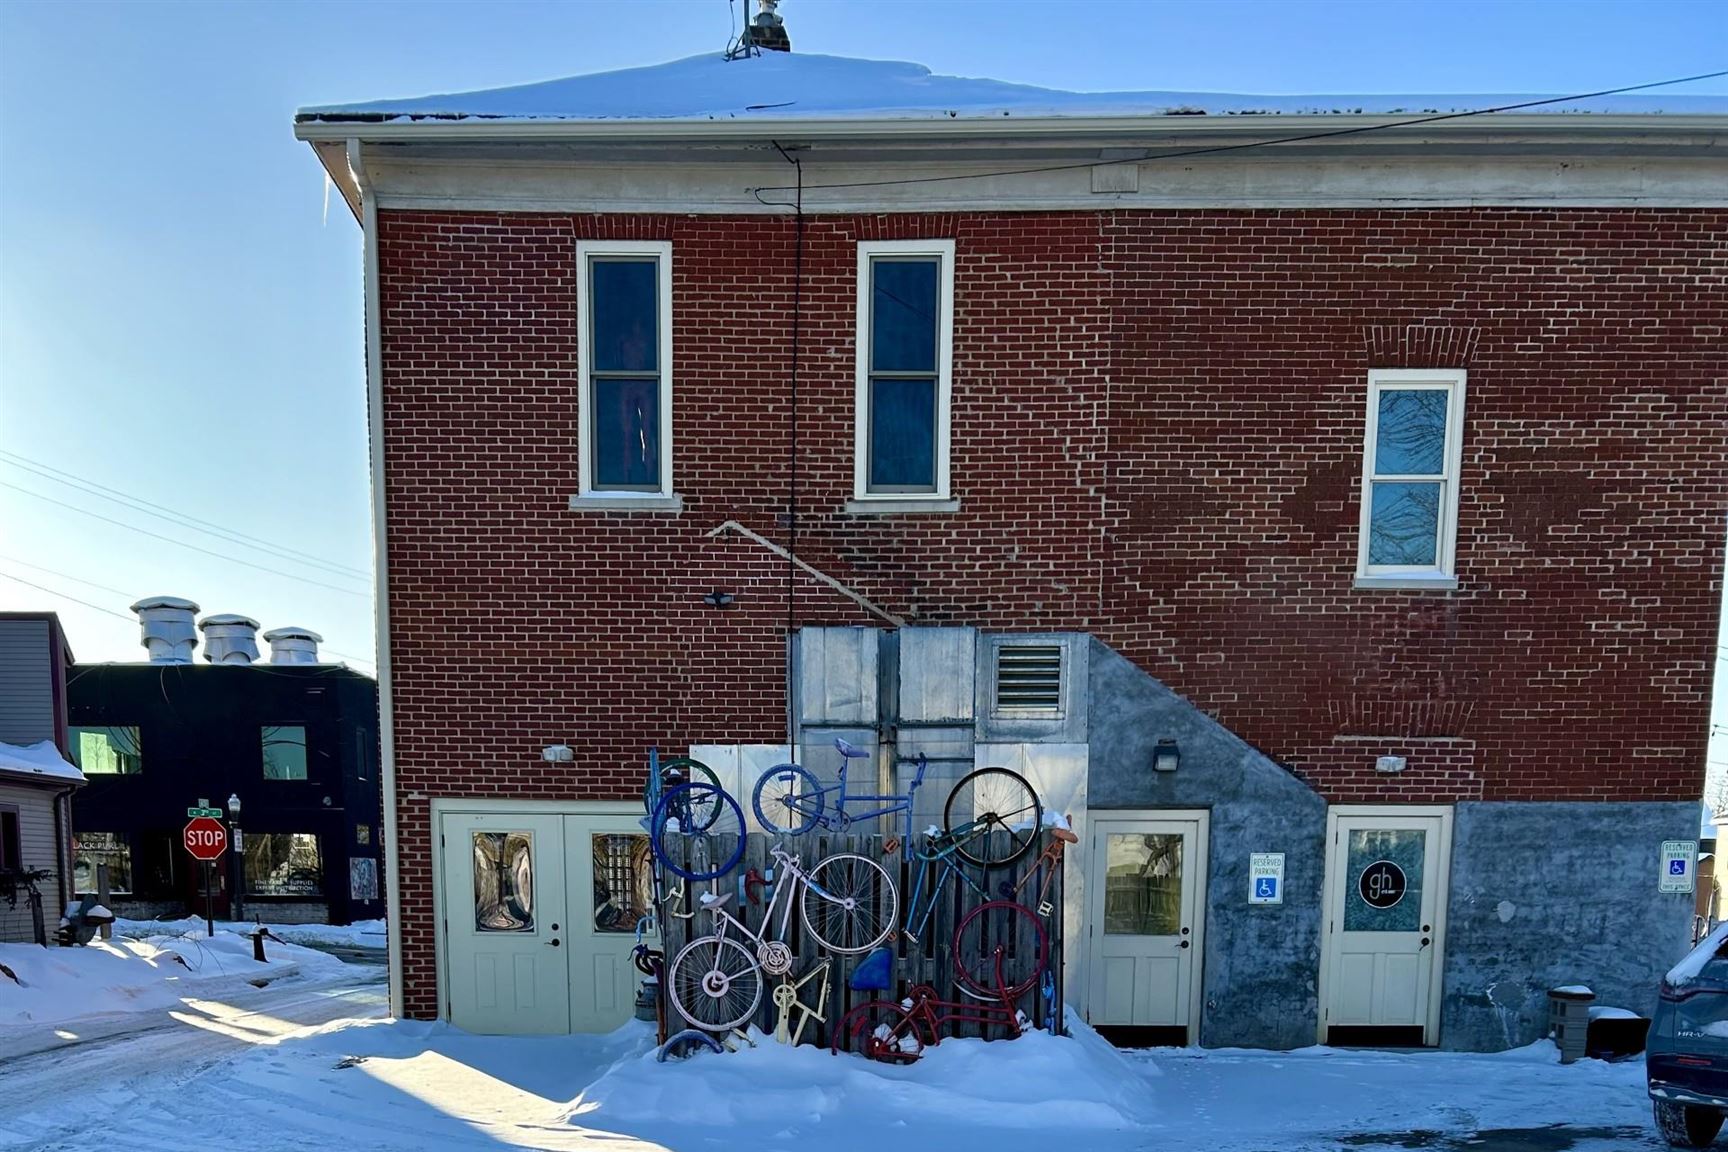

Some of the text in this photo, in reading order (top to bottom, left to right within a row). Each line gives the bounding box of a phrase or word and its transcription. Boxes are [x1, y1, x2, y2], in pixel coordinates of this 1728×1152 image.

[187, 830, 224, 847] STOP
[72, 841, 96, 850] LACK
[1253, 858, 1281, 867] RESERVED
[1254, 866, 1280, 876] PARKING
[1369, 866, 1392, 900] gh
